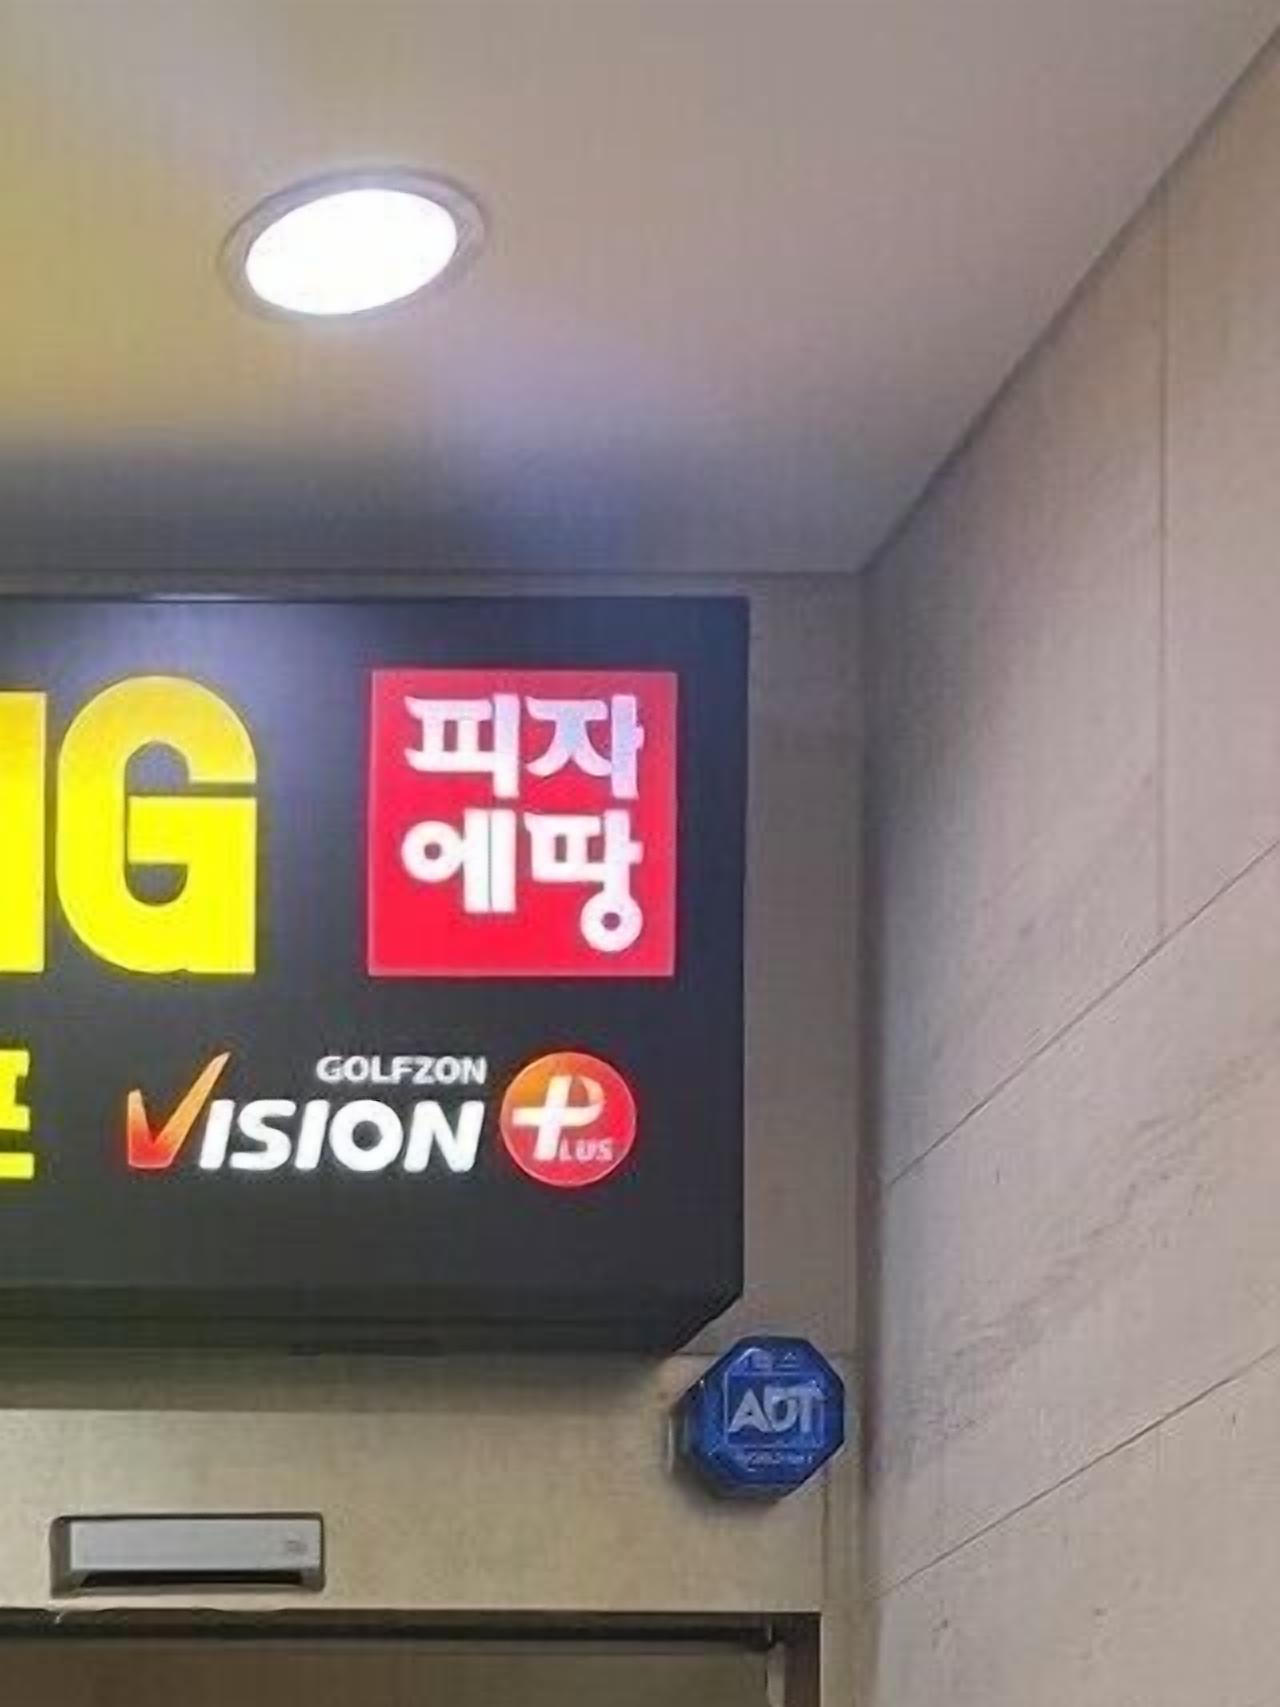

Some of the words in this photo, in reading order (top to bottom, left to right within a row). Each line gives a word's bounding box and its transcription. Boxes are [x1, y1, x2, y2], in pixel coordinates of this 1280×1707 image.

[404, 693, 644, 799] 피자
[401, 808, 644, 953] 에땅
[127, 1051, 486, 1173] VISION
[316, 1054, 488, 1086] GOLFZON
[727, 1384, 824, 1433] ADT
